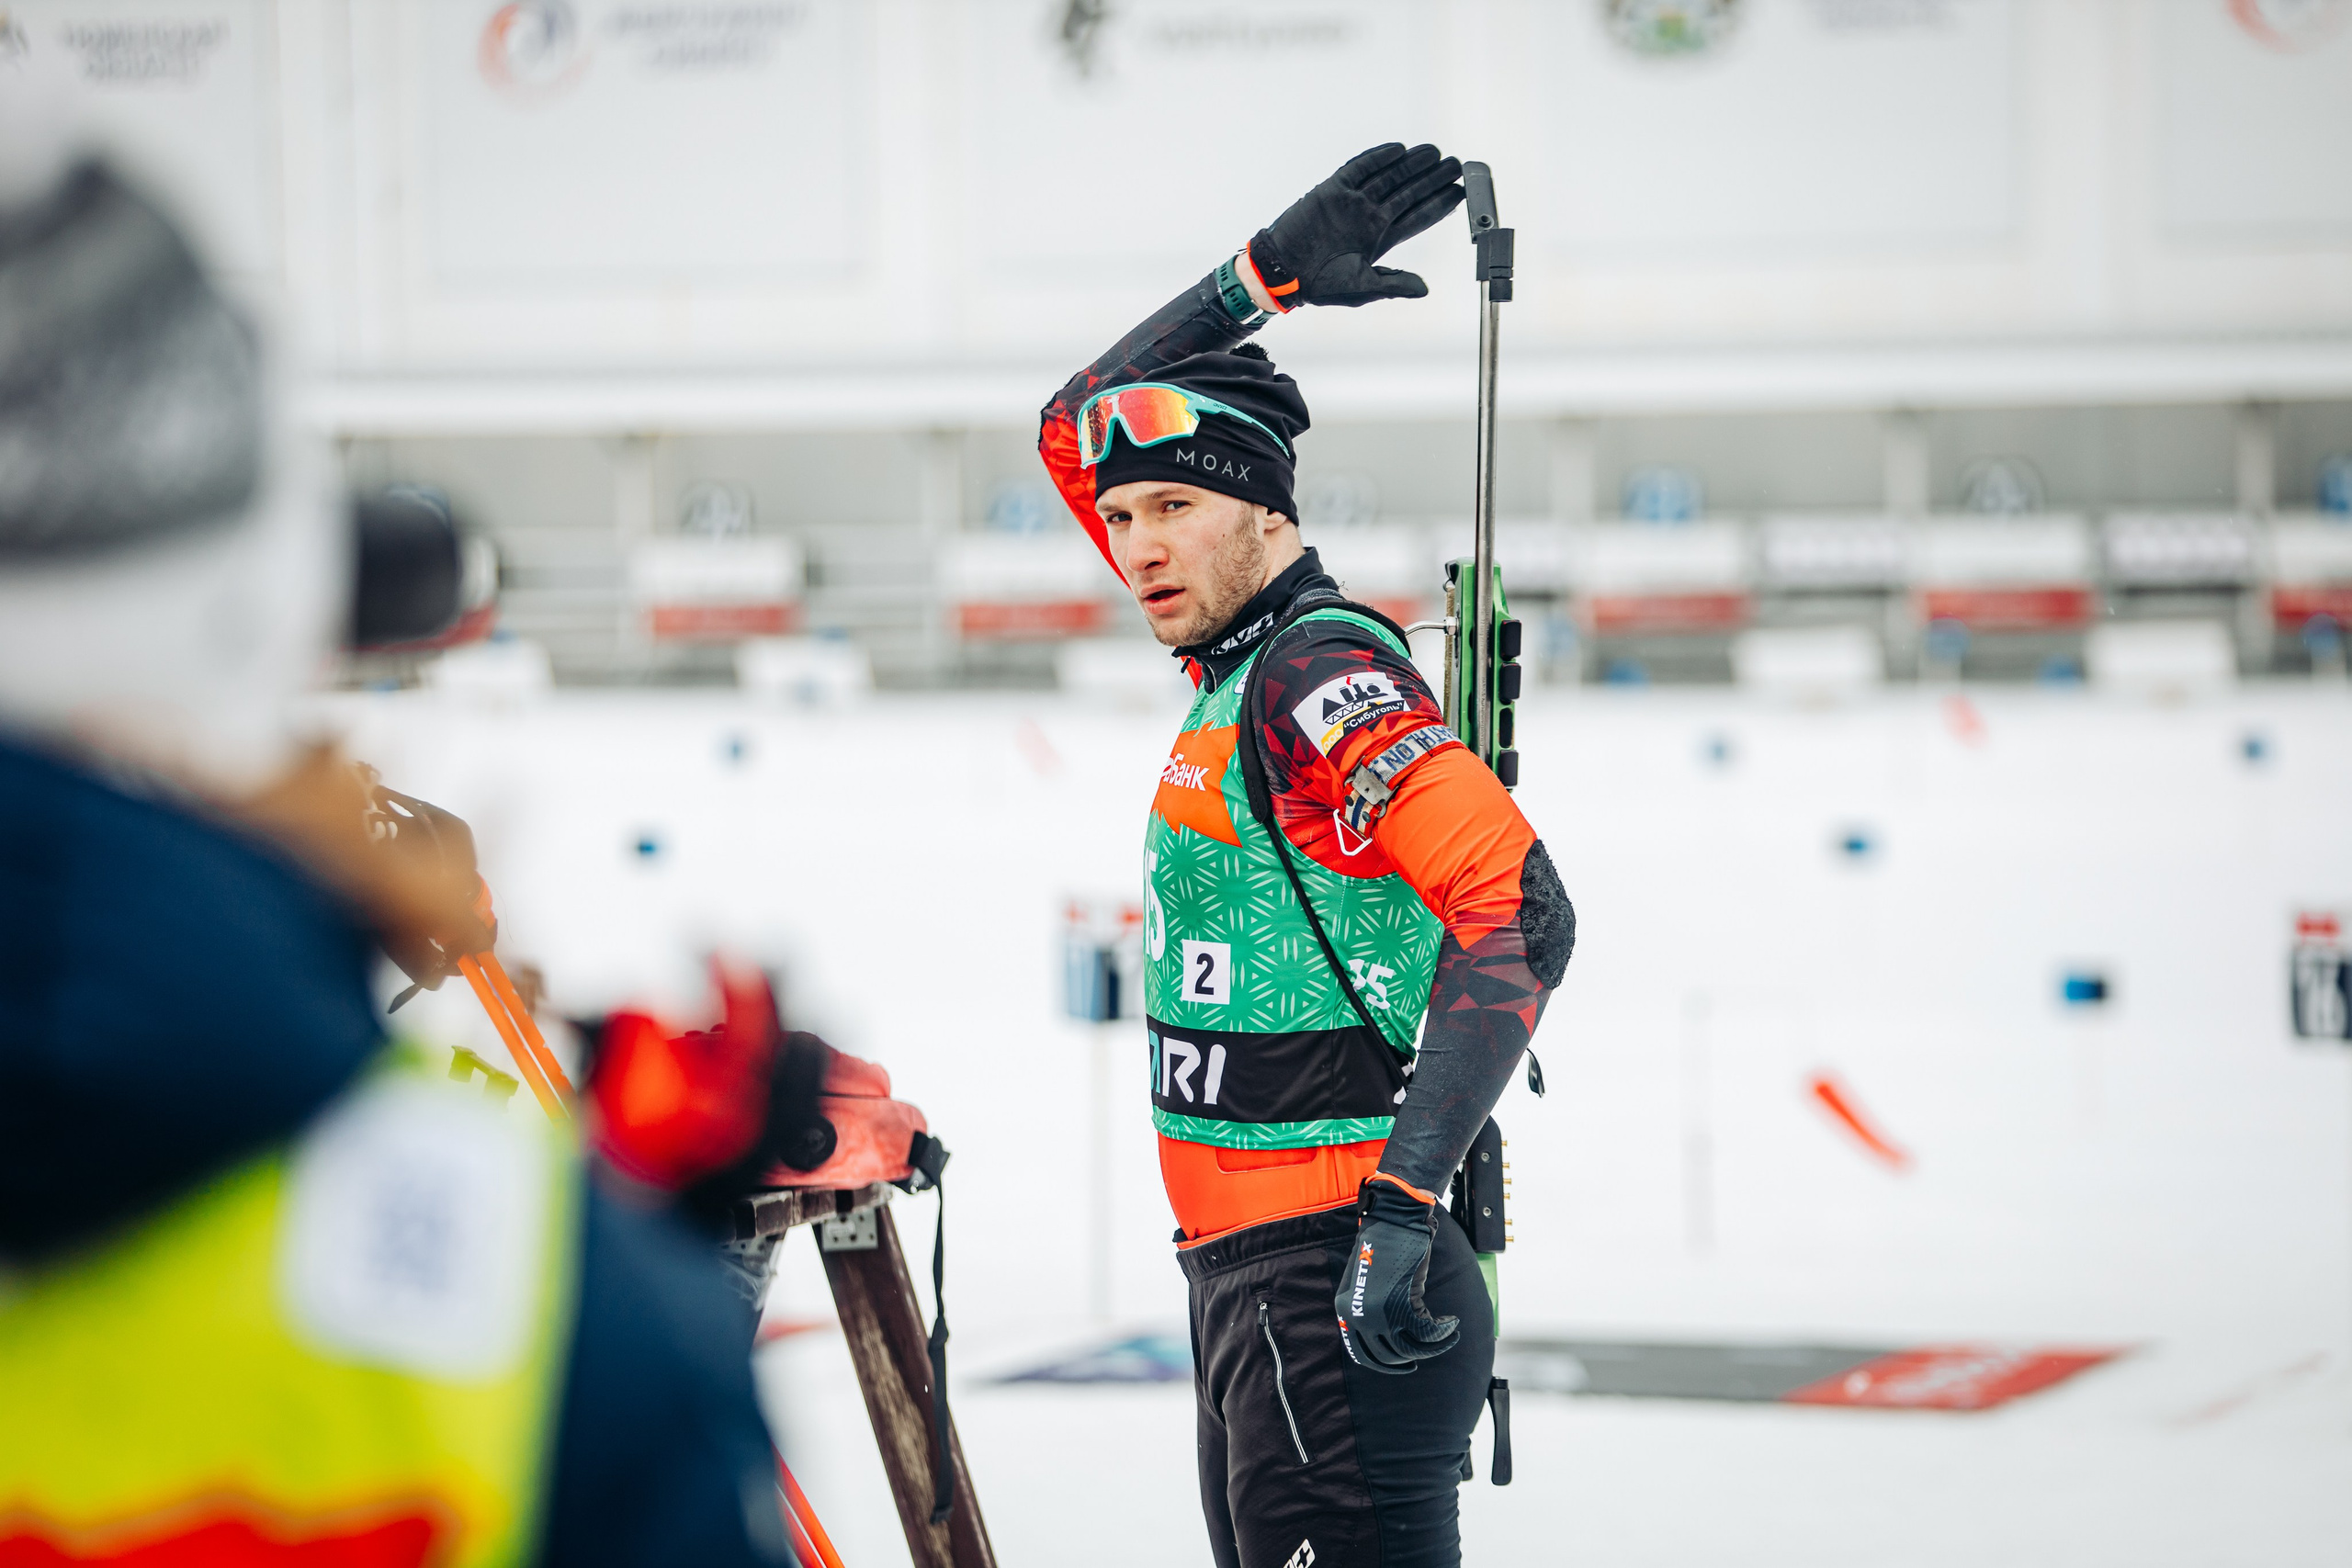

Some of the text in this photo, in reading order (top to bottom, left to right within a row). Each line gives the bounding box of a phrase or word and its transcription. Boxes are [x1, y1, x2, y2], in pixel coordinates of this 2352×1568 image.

[1175, 446, 1251, 482] MOAX
[1194, 953, 1215, 995] 2
[1351, 1240, 1374, 1317] KINETIXX
